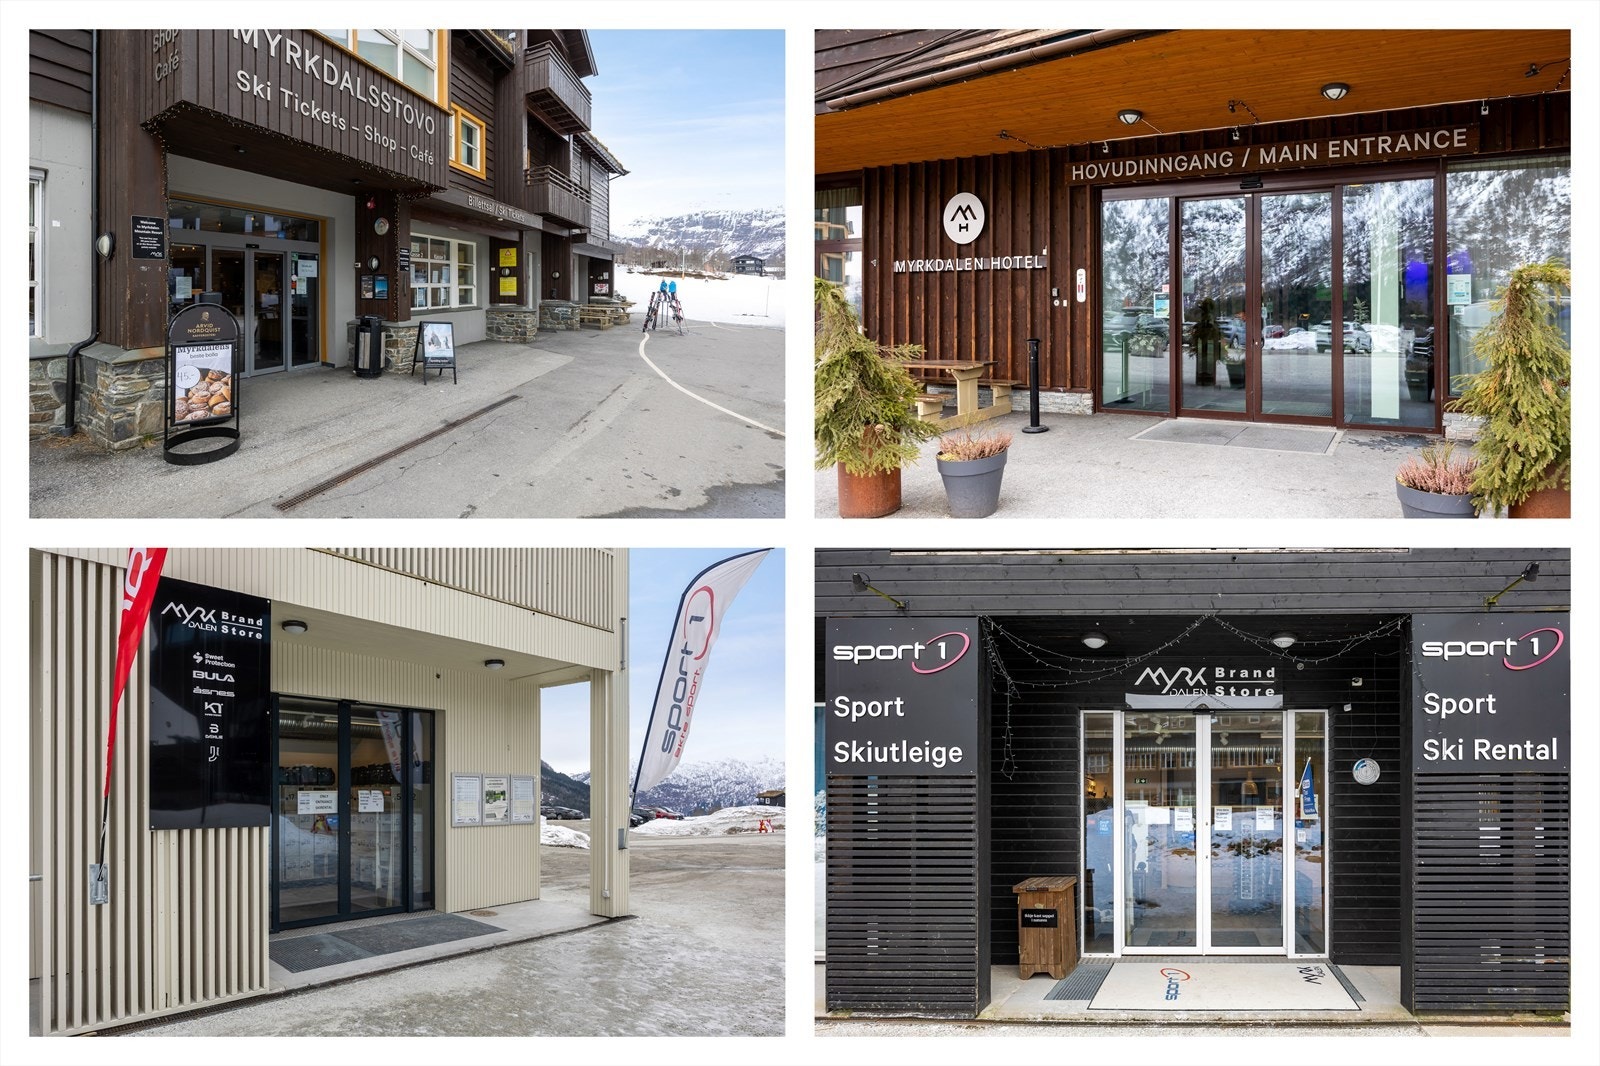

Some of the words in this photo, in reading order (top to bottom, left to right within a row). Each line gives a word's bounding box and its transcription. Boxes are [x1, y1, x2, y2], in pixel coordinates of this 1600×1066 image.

[155, 49, 179, 82] Café
[233, 29, 435, 135] MYRKDALSSTOVO
[236, 69, 272, 101] Ski
[280, 87, 347, 131] Tickets
[364, 124, 397, 153] Shop
[410, 144, 435, 165] Café
[1072, 150, 1233, 180] HOVUDINNGANG
[1242, 148, 1250, 167] /
[1260, 142, 1318, 164] MAIN
[1328, 128, 1467, 158] ENTRANCE
[468, 195, 495, 213] Billettsal
[499, 204, 508, 217] Ski
[895, 257, 984, 273] MYRKDALEN
[991, 254, 1043, 270] HOTEL
[161, 601, 217, 625] MYRK
[221, 611, 263, 626] Brand
[188, 621, 217, 632] DALEN
[221, 625, 263, 640] Store
[832, 641, 926, 665] sport
[937, 641, 946, 660] 1
[1421, 637, 1518, 661] sport
[1530, 637, 1539, 656] 1
[205, 659, 236, 668] Protection
[193, 670, 235, 683] BULA
[1134, 667, 1208, 694] MYRK
[1215, 667, 1275, 678] Brand
[193, 685, 235, 697] åsnes
[661, 641, 694, 755] sport
[685, 667, 702, 717] sport
[1169, 688, 1209, 697] DALEN
[1215, 685, 1275, 697] Store
[833, 695, 905, 722] Sport
[1423, 692, 1497, 719] Sport
[833, 740, 963, 768] Skiutleige
[1423, 738, 1464, 761] Ski
[1474, 737, 1557, 761] Rental
